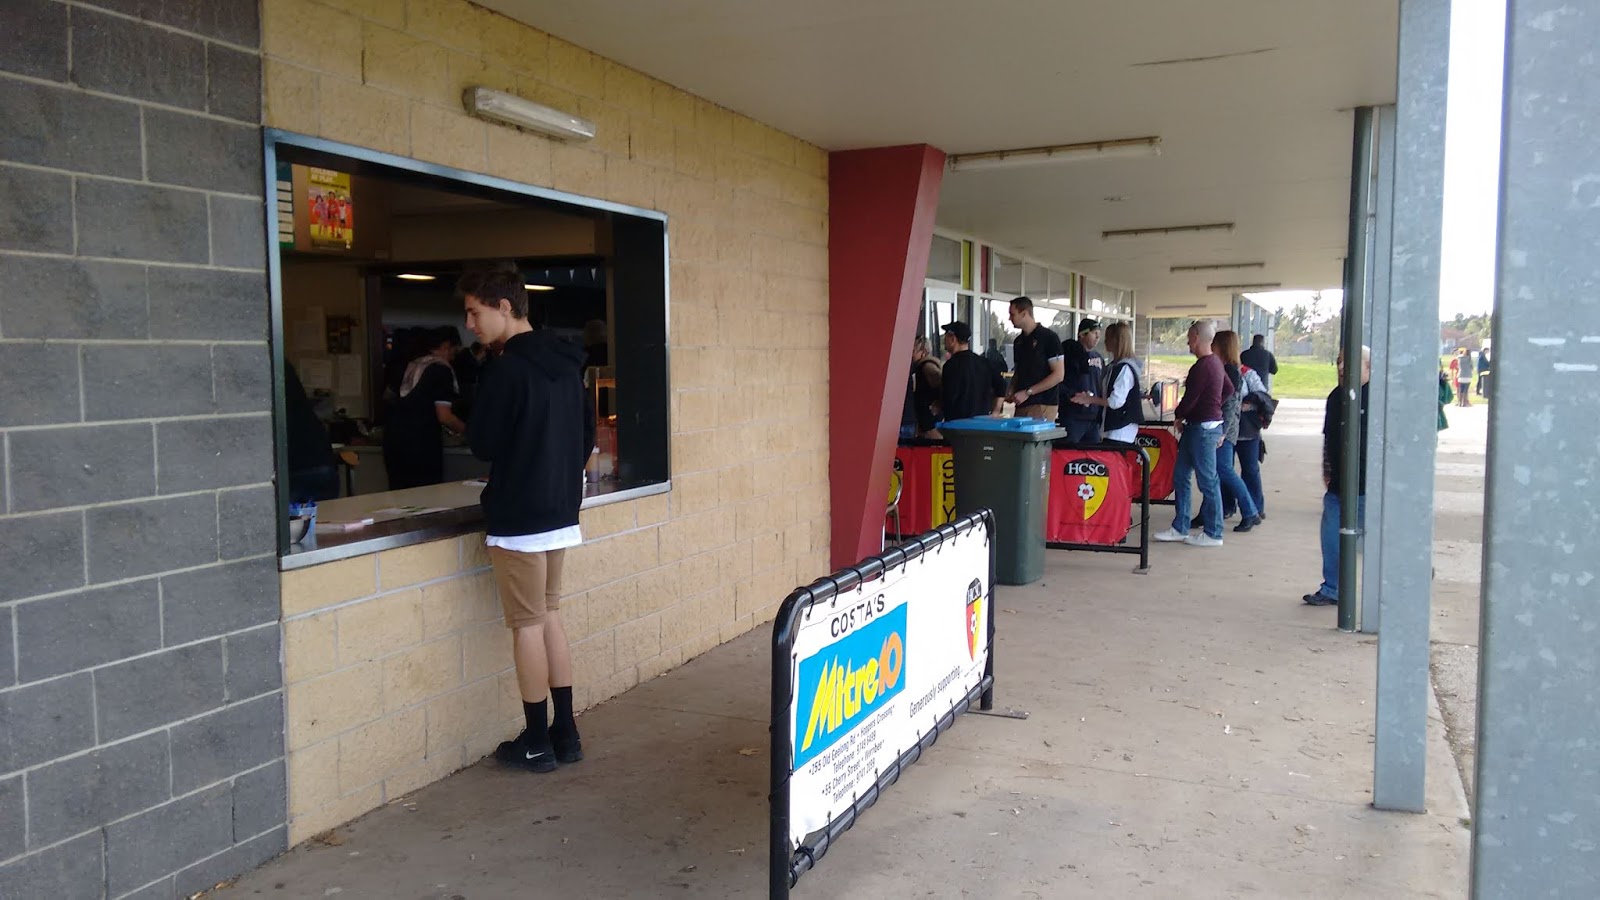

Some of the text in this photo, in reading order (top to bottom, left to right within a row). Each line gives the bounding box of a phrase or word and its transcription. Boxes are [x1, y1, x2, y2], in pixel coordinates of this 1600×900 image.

[1068, 462, 1106, 476] HCSC
[830, 593, 885, 638] COSTA'S
[910, 683, 938, 718] Generously
[823, 752, 831, 767] Old
[847, 759, 861, 777] Street
